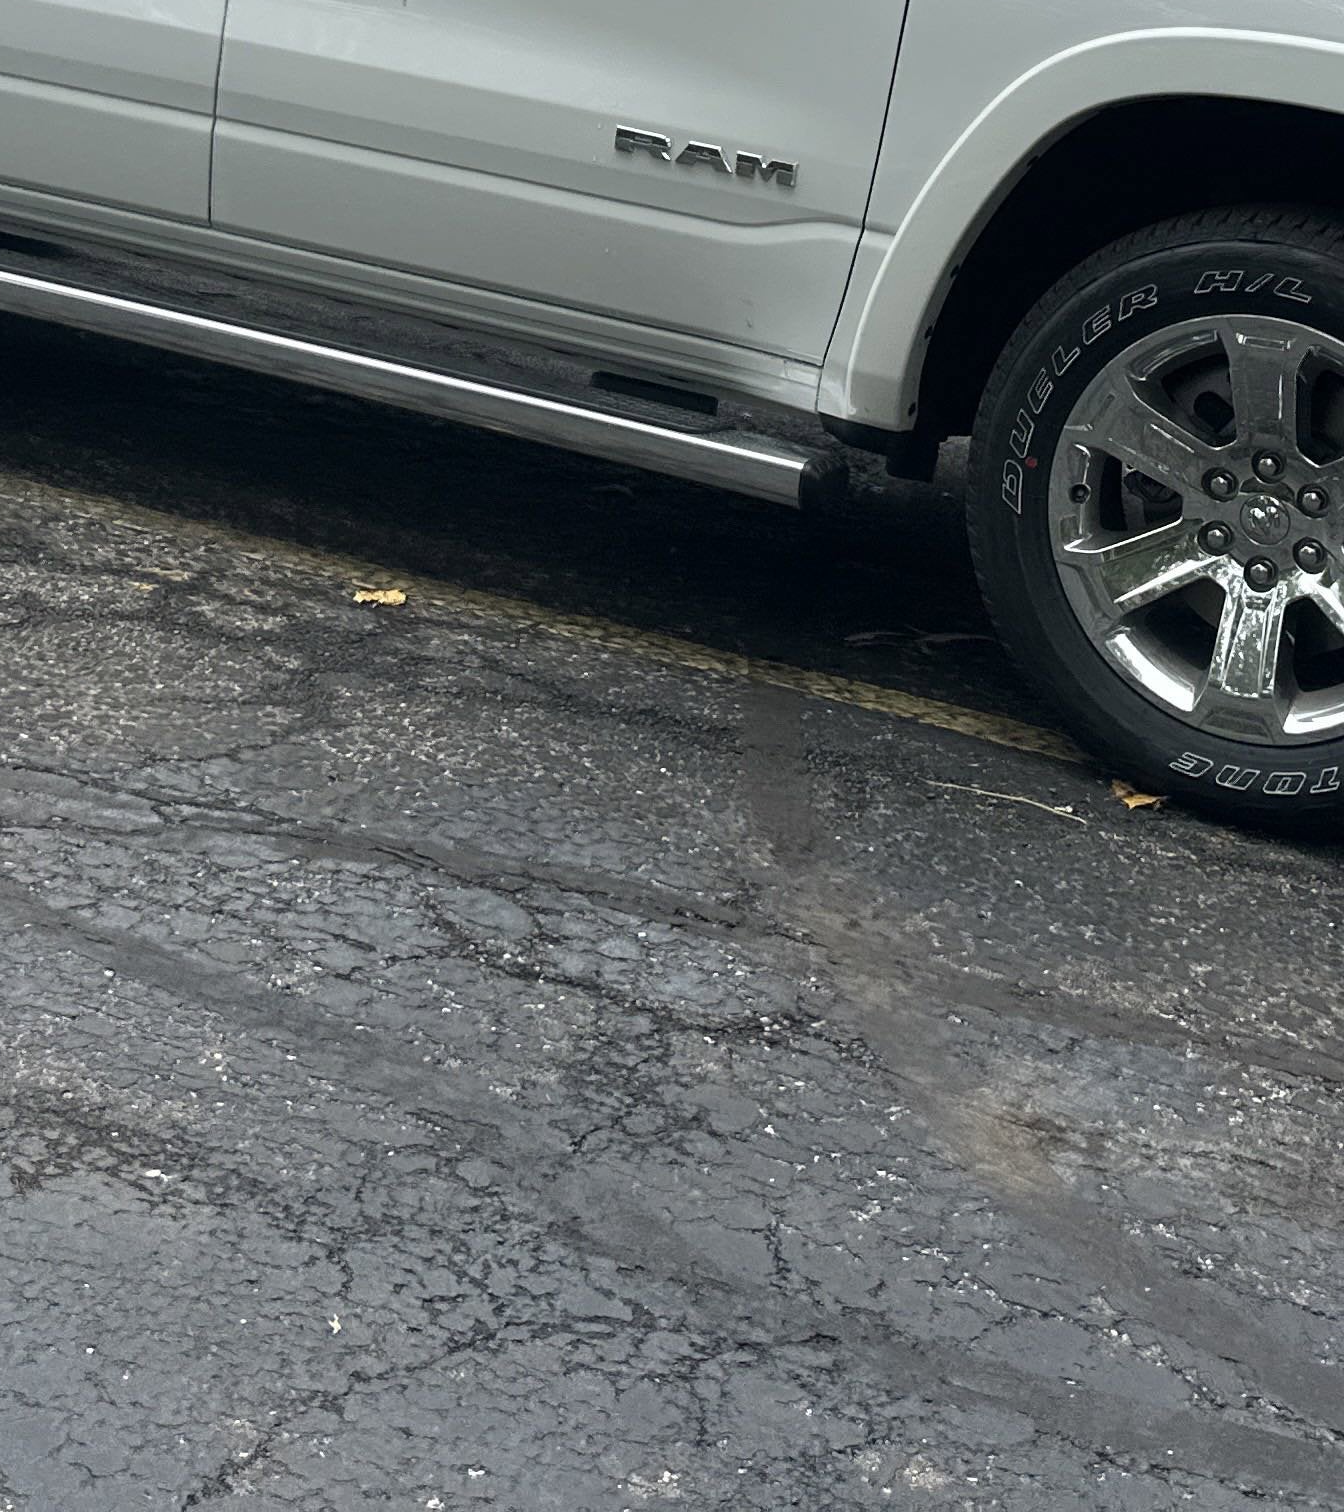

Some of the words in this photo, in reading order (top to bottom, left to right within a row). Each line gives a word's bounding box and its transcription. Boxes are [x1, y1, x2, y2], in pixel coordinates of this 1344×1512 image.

[614, 124, 799, 188] RAM
[1001, 284, 1158, 515] DUELER
[1194, 270, 1312, 303] H/L
